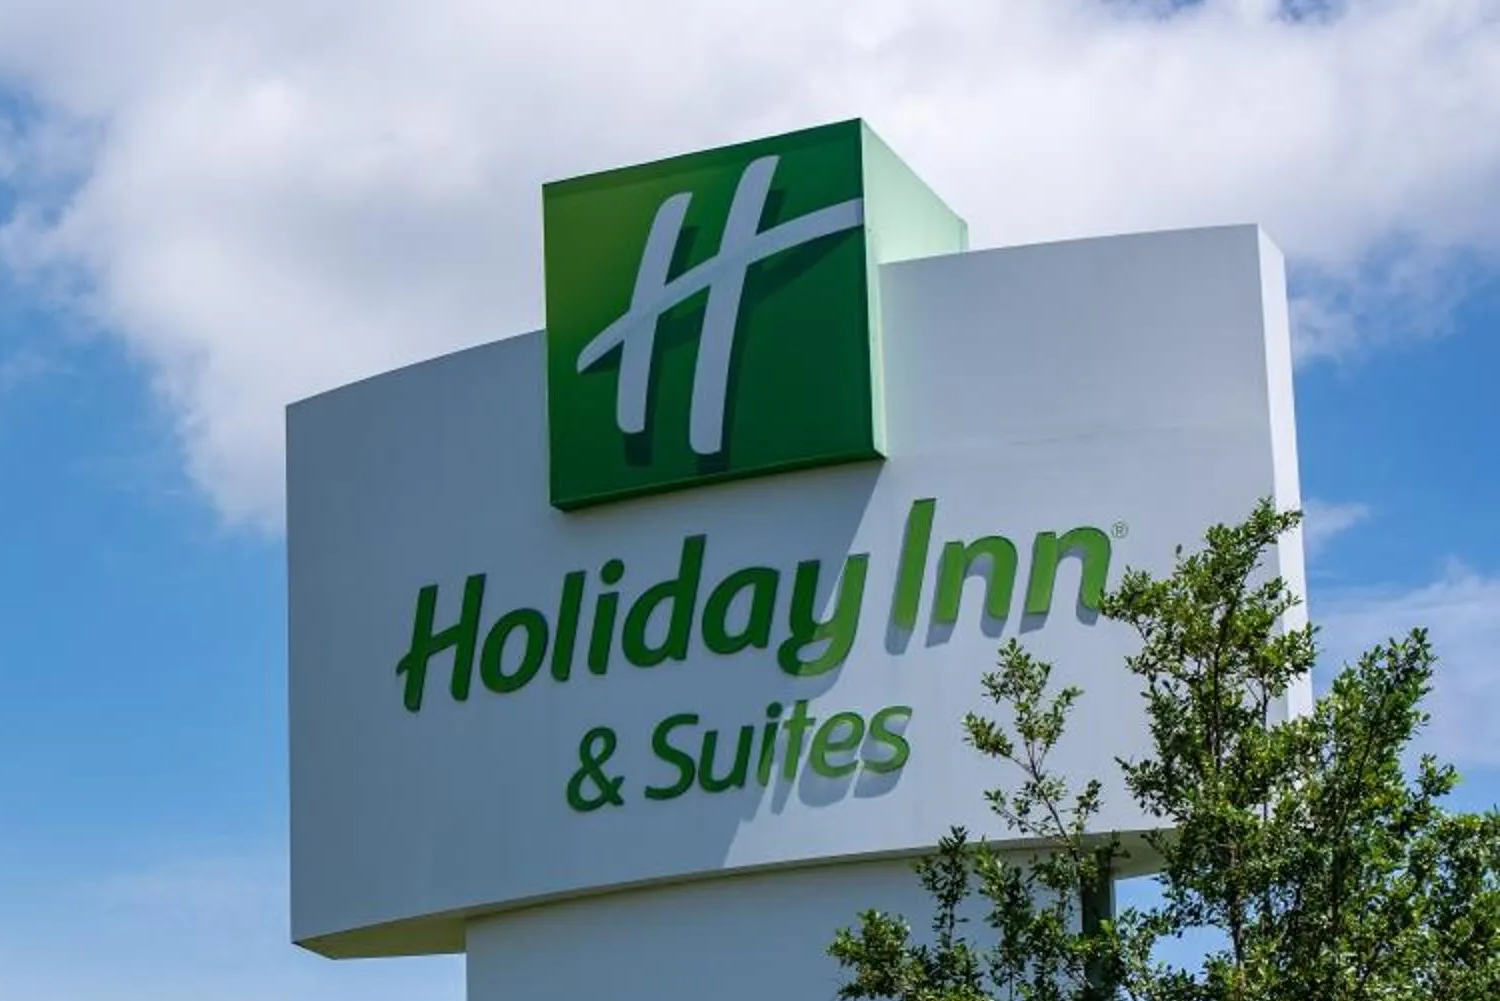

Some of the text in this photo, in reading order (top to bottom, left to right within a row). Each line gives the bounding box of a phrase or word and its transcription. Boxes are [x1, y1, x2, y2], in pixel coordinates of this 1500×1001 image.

[577, 155, 864, 455] H
[396, 534, 870, 712] Holiday
[894, 498, 1111, 631] Inn
[566, 700, 913, 812] & Suites
